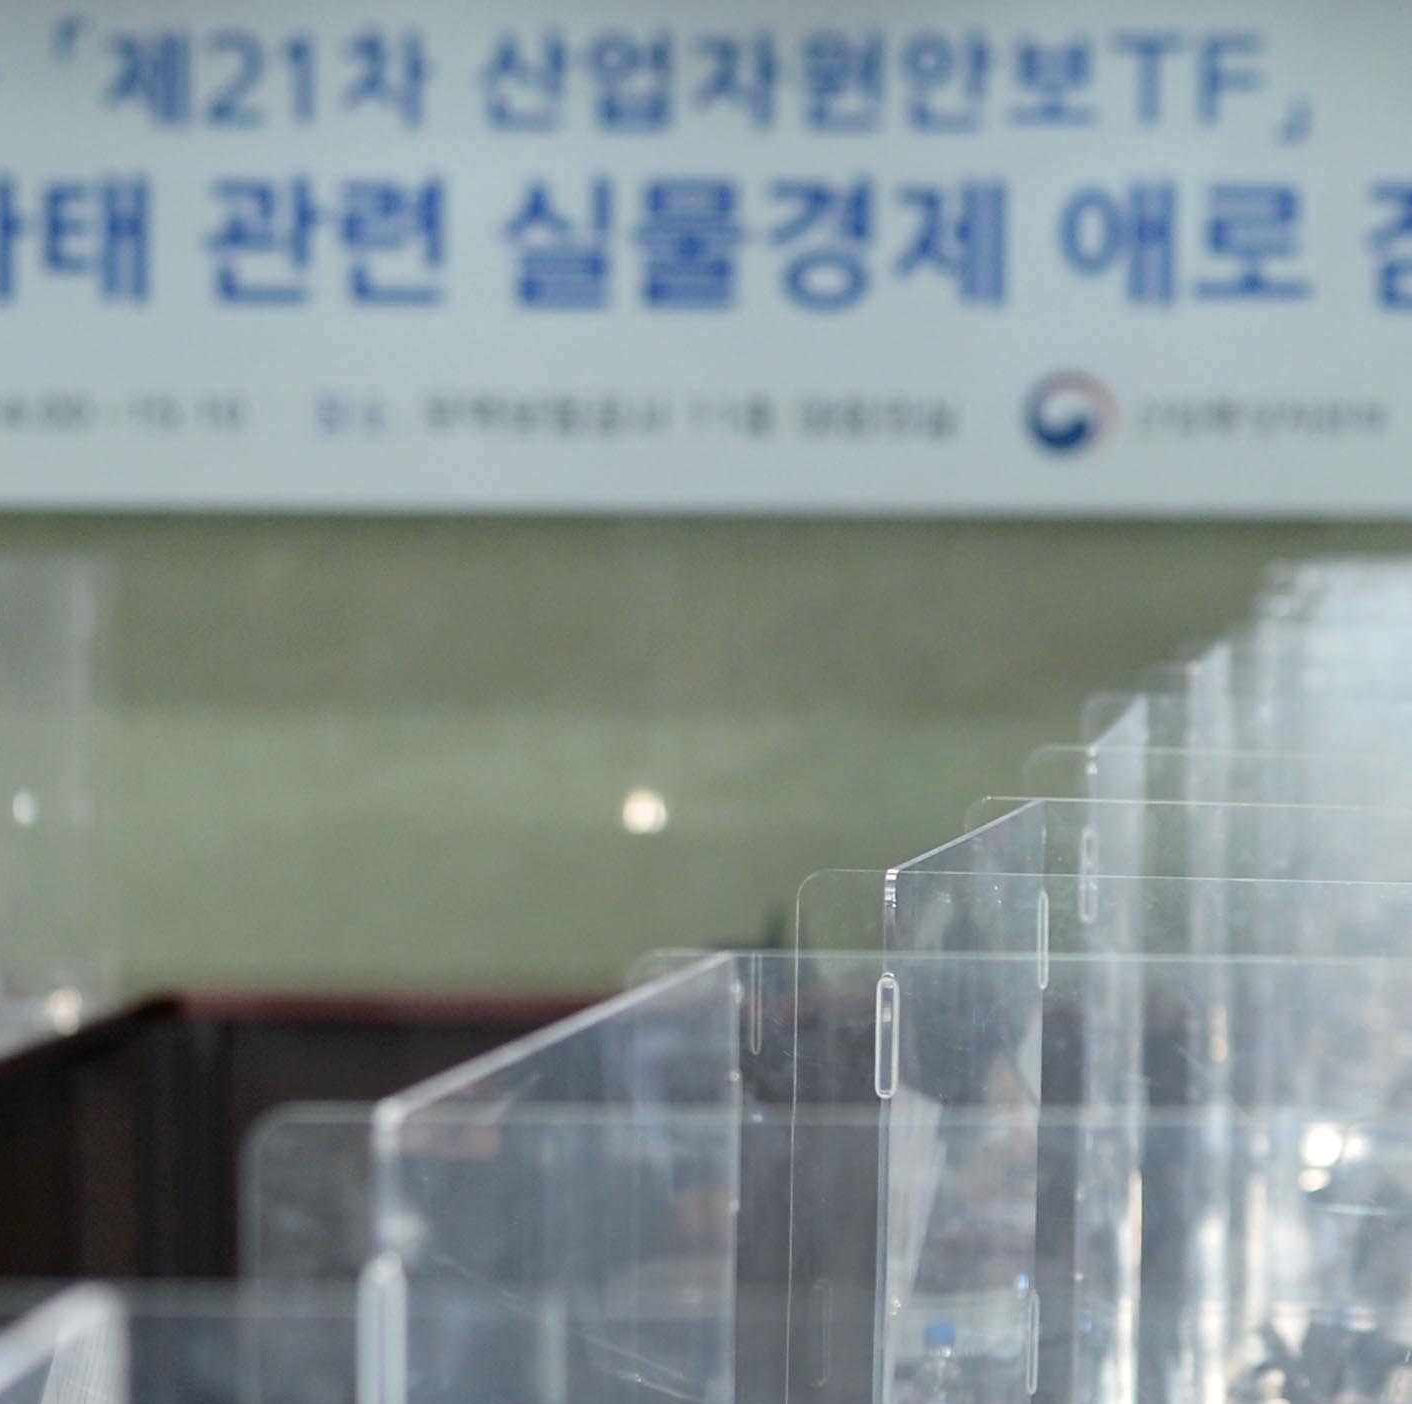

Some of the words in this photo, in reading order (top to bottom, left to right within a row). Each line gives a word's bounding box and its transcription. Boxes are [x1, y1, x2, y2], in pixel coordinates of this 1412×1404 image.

[204, 175, 448, 308] 관련
[501, 175, 1011, 312] 실물경제
[1055, 180, 1309, 306] 애로
